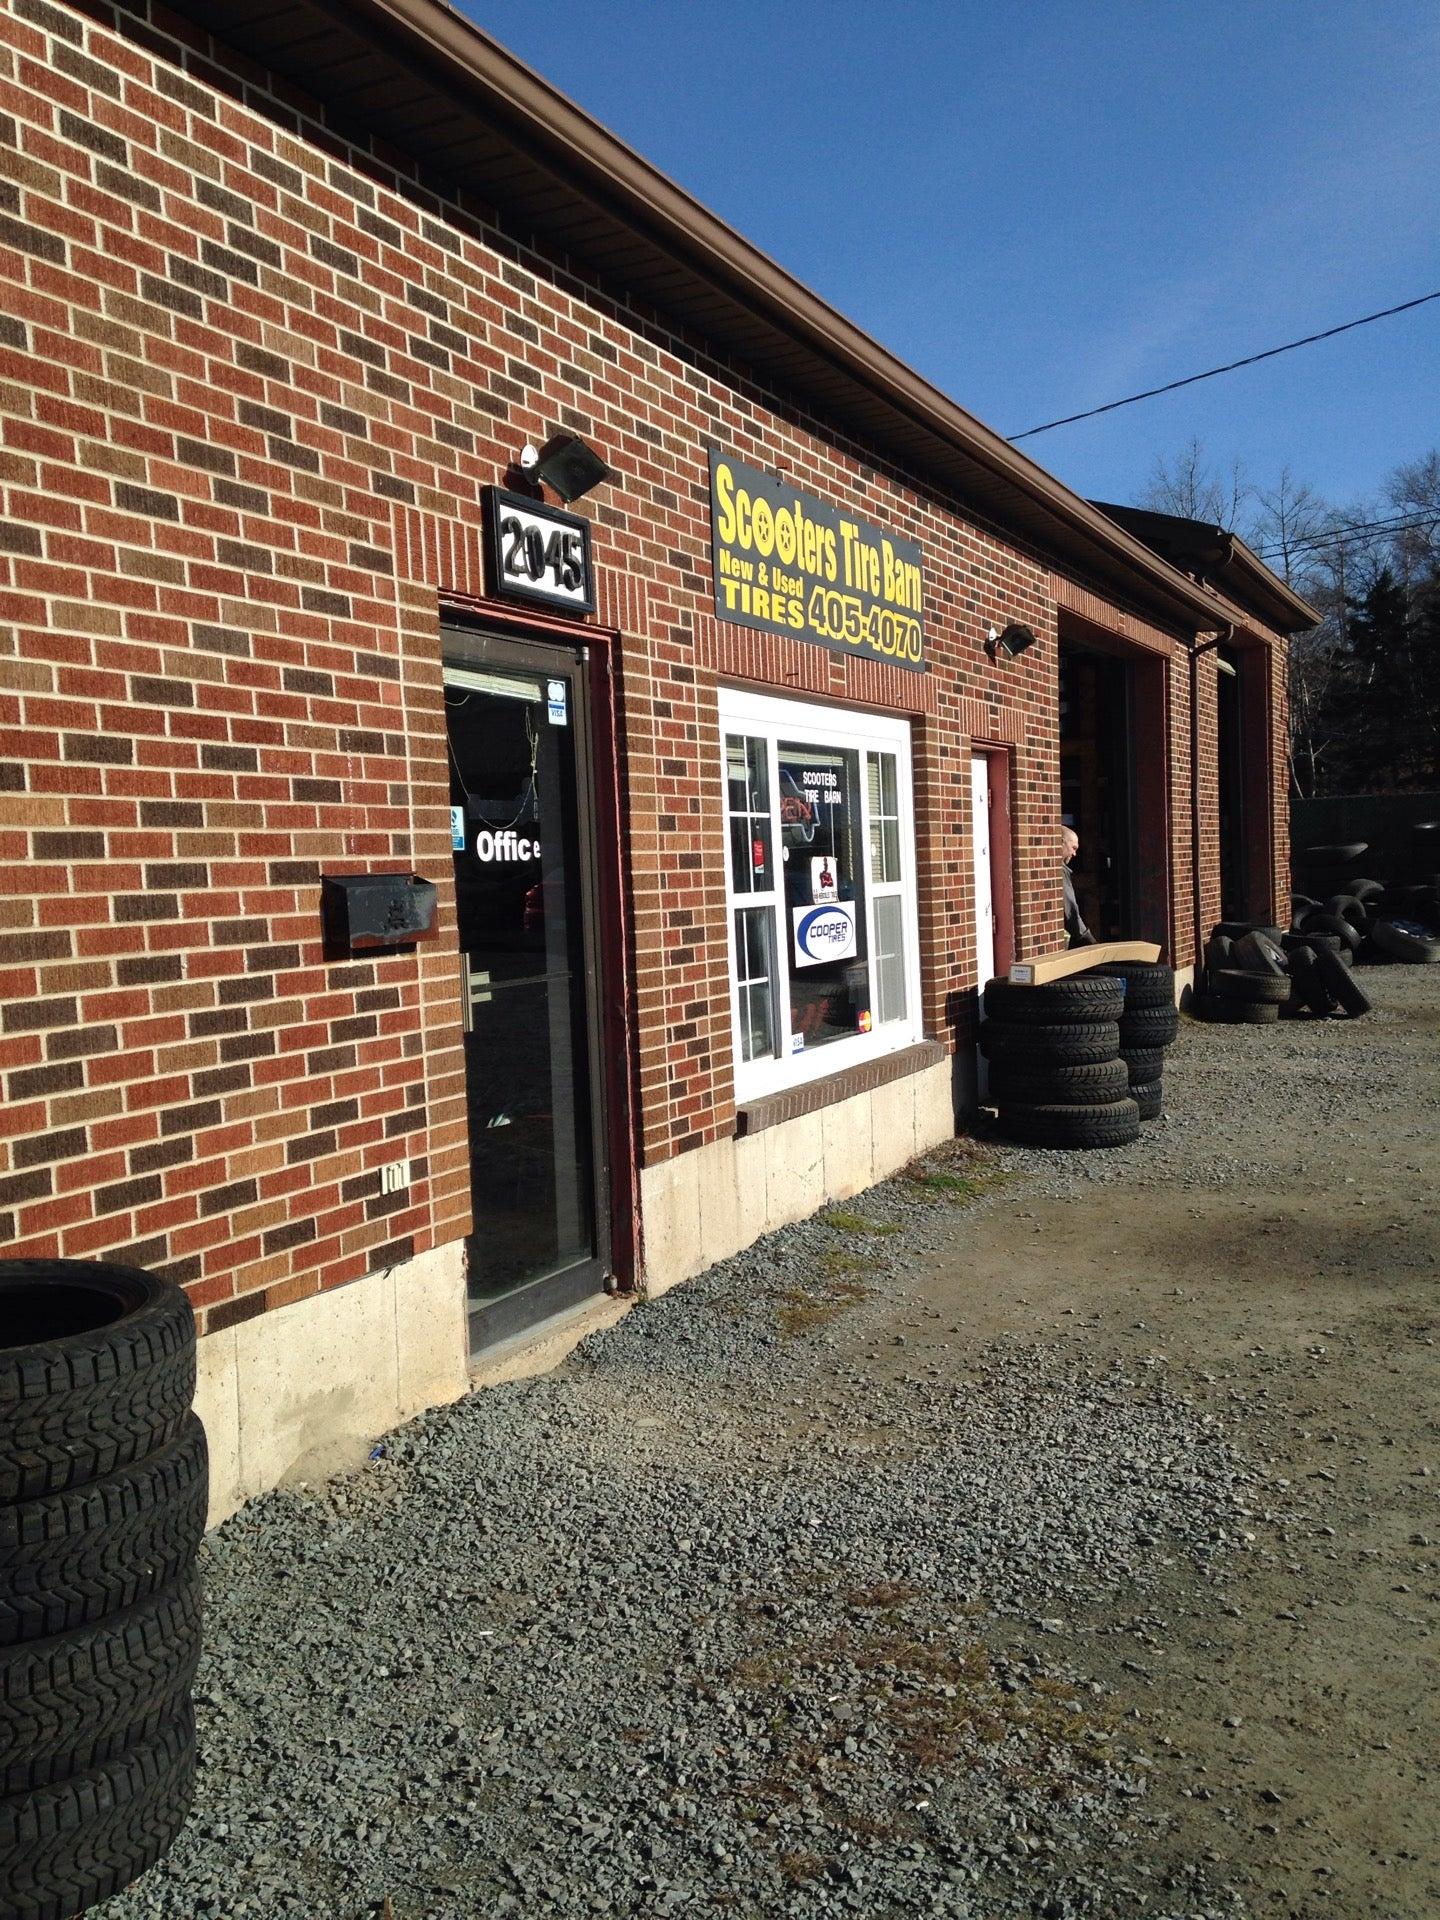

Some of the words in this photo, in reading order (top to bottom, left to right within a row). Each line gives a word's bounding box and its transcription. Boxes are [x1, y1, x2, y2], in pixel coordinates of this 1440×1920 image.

[500, 515, 584, 592] 2045
[716, 463, 837, 582] Scooters
[839, 519, 881, 598] Tire
[881, 538, 922, 613] Barn
[719, 548, 754, 581] New
[757, 561, 769, 585] &
[772, 566, 804, 598] Used
[720, 576, 805, 629] TIRES
[808, 585, 922, 663] 405-4070
[802, 771, 837, 787] SCOOTERS
[804, 789, 819, 803] TIRE
[824, 790, 842, 804] BARN
[476, 830, 541, 862] Office
[810, 921, 848, 938] COOPER
[828, 933, 846, 943] TIRES
